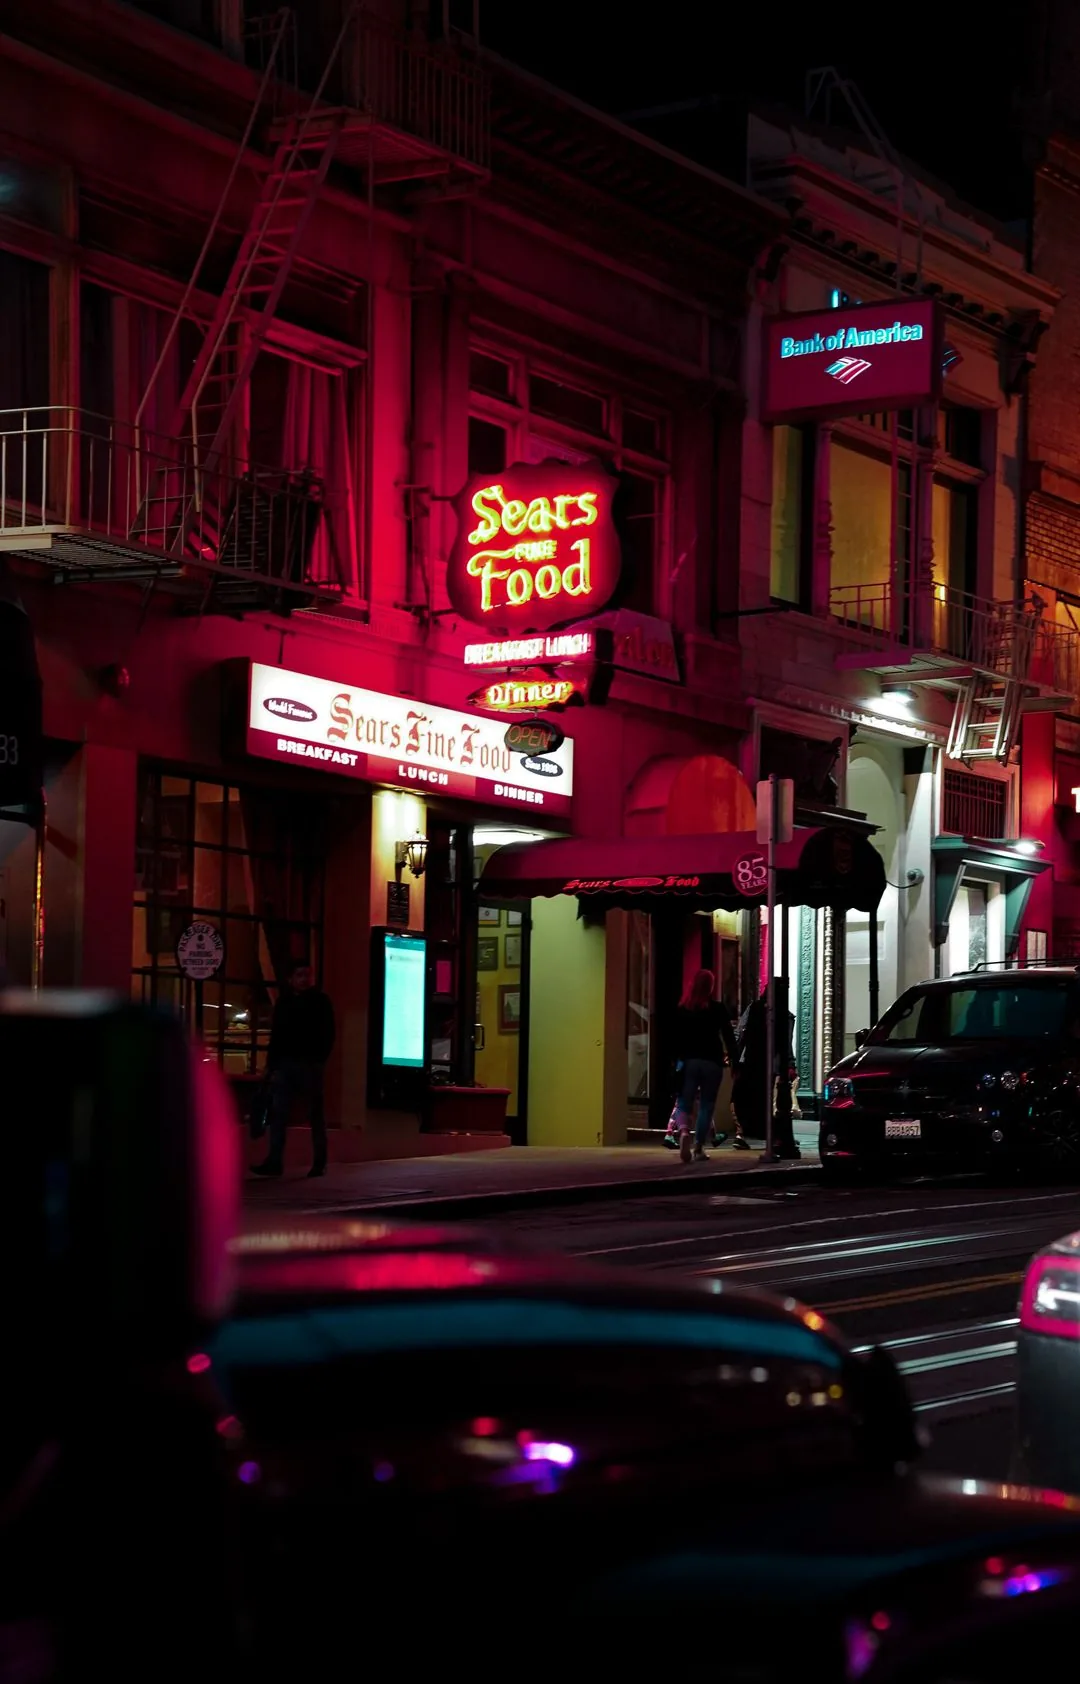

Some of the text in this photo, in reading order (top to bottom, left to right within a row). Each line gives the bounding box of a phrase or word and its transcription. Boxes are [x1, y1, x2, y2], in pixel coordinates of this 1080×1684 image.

[781, 321, 923, 359] Bank of America
[467, 484, 599, 545] Sears
[466, 538, 593, 612] Food
[326, 693, 401, 750] Sears
[405, 711, 456, 762] Fine
[507, 725, 551, 750] OPEN
[276, 738, 544, 805] BREAKFAST LUNCH DINNER
[737, 856, 767, 883] 85
